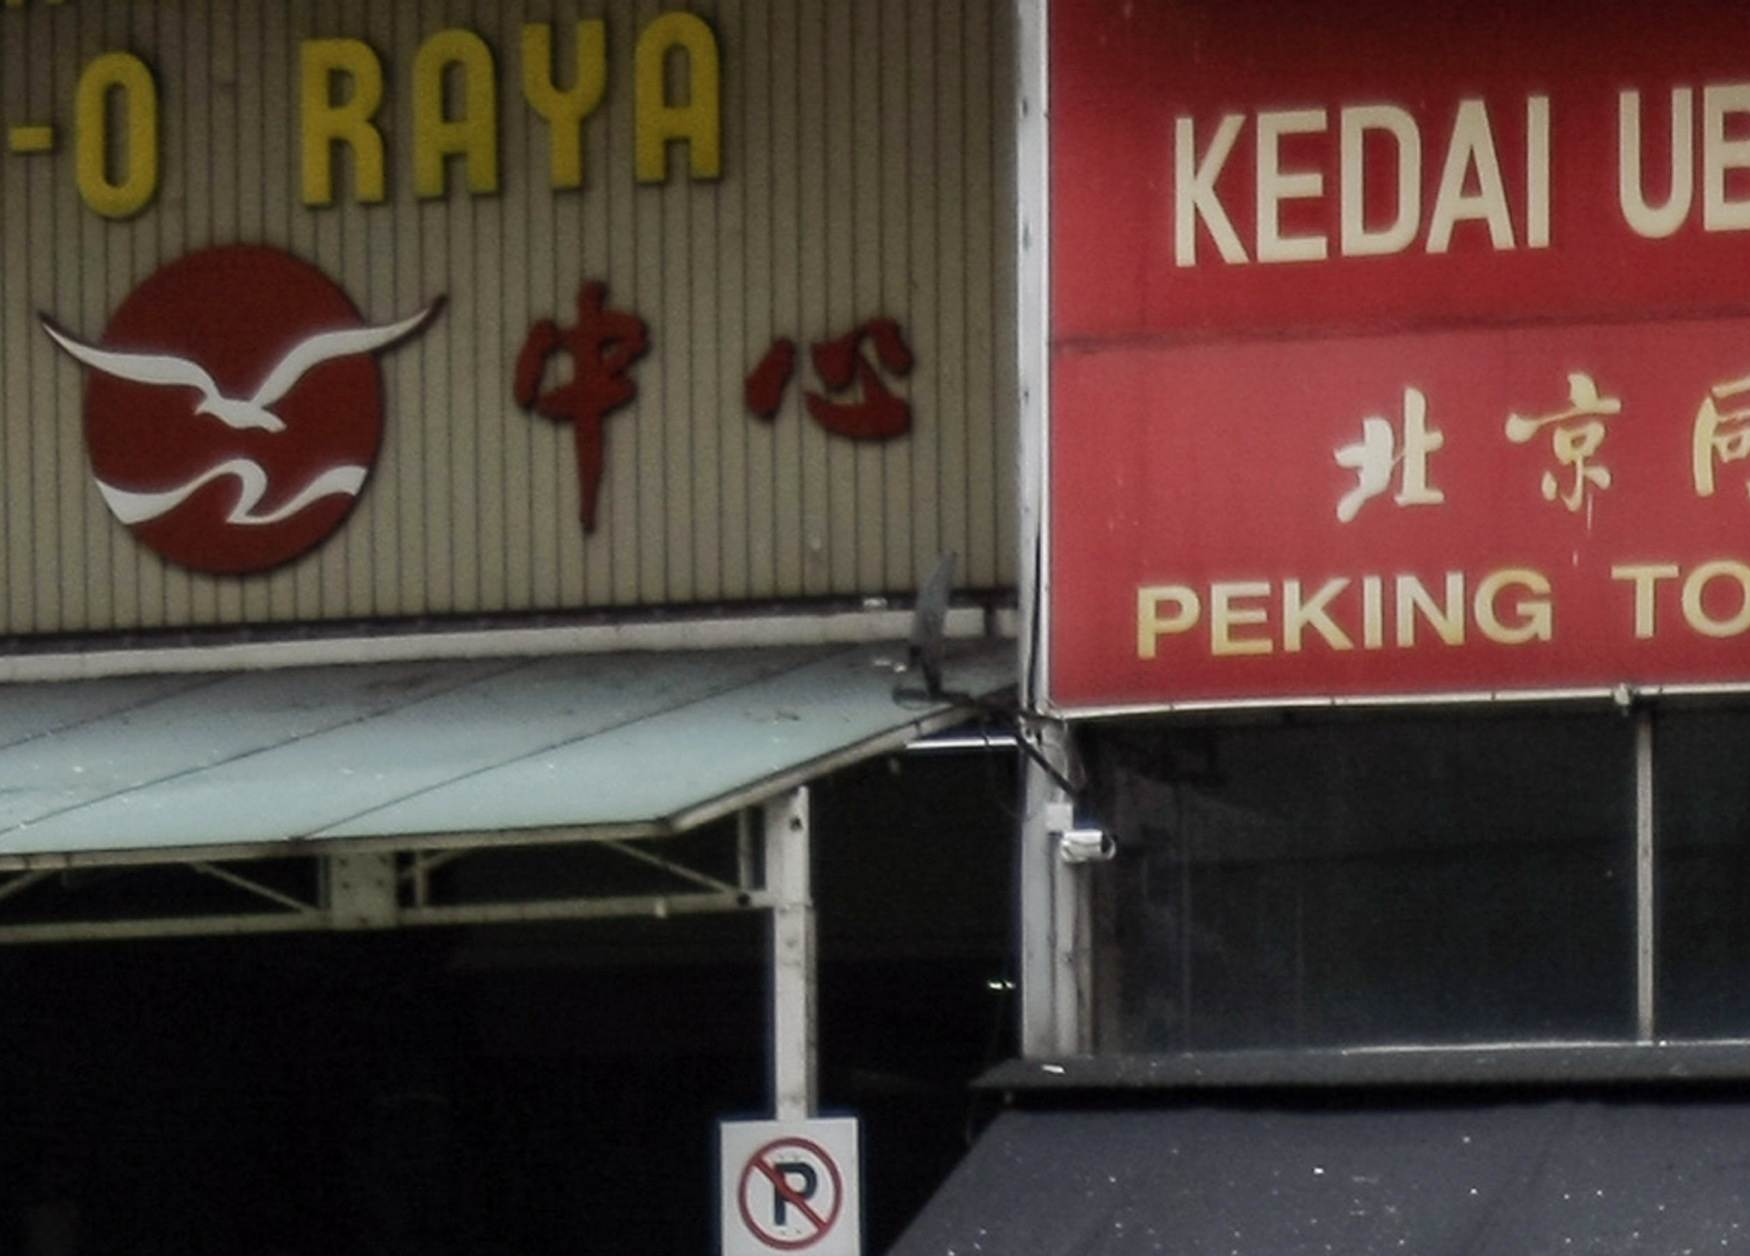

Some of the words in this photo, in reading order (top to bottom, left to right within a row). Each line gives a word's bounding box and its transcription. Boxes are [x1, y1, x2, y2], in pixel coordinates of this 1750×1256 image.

[300, 11, 723, 207] RAYA
[1173, 95, 1550, 268] KEDAI
[514, 280, 915, 535] 中心
[1137, 568, 1552, 660] PEKING
